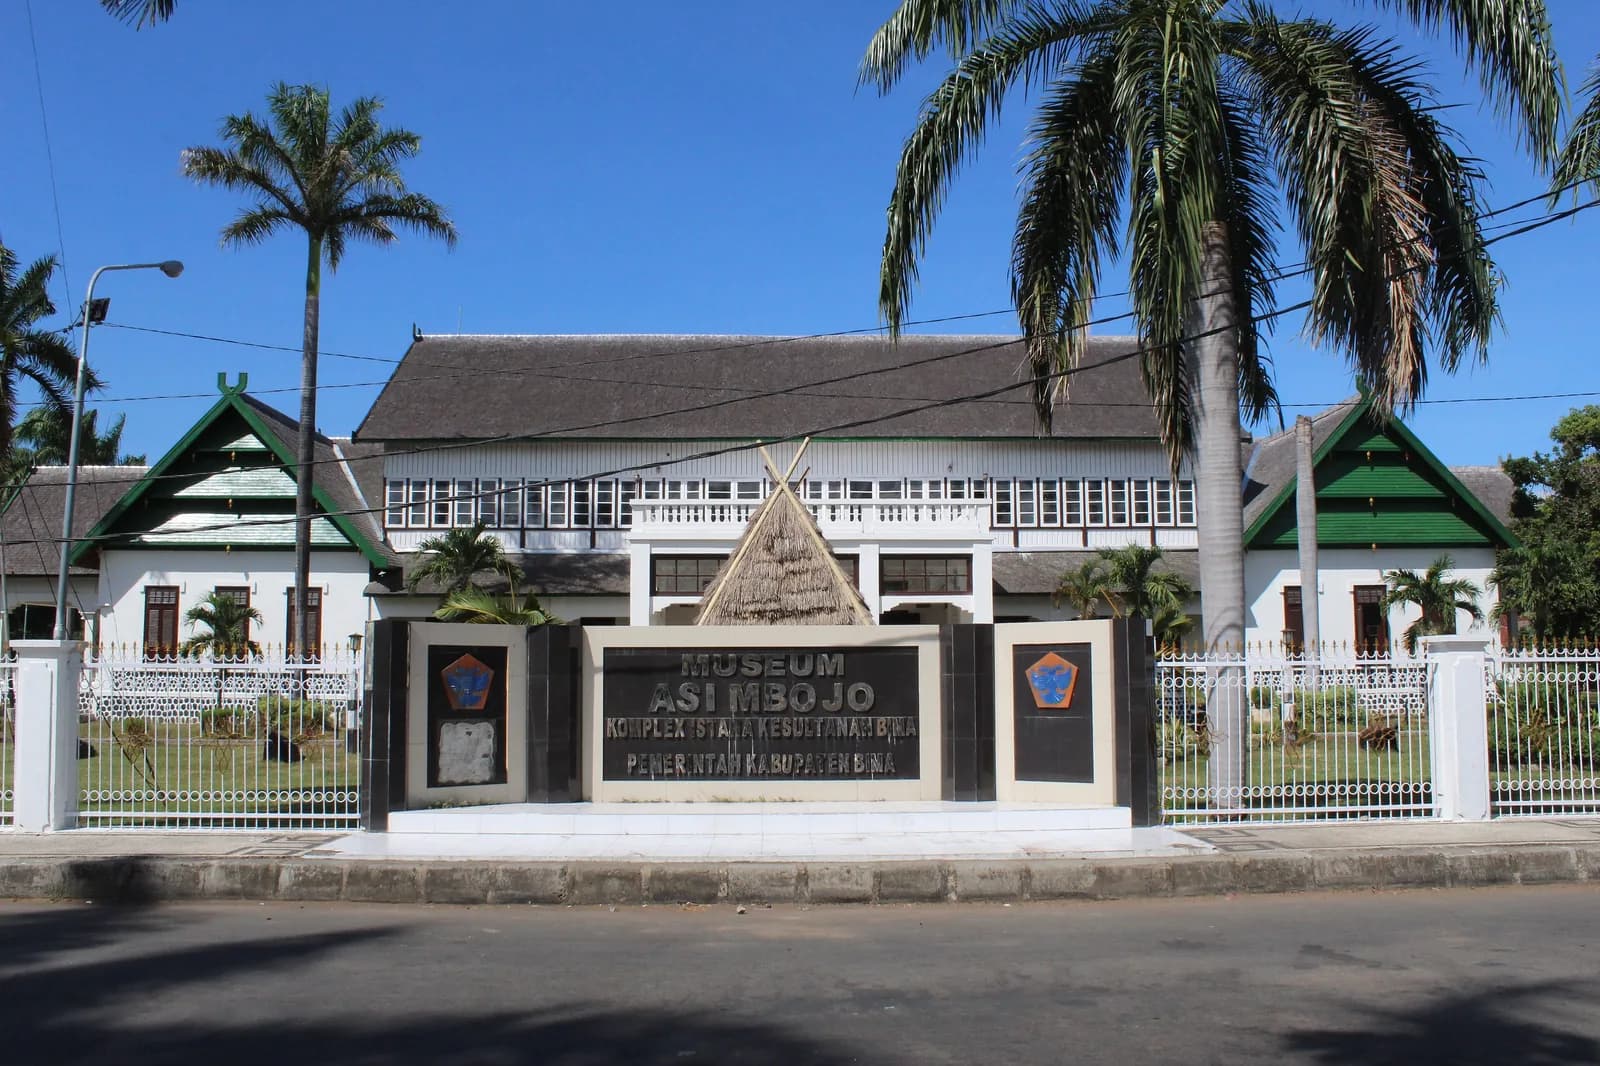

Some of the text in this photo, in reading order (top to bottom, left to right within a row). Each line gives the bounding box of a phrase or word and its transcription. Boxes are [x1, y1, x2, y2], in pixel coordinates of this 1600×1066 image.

[681, 653, 845, 677] MUSEUM
[648, 681, 875, 713] ASI MBOJO
[606, 717, 685, 738] KOMPLEX
[758, 717, 872, 738] KESULTANAN
[876, 717, 917, 738] BIMA
[627, 753, 895, 774] PEMERINTAH KABUPATEN BIMA
